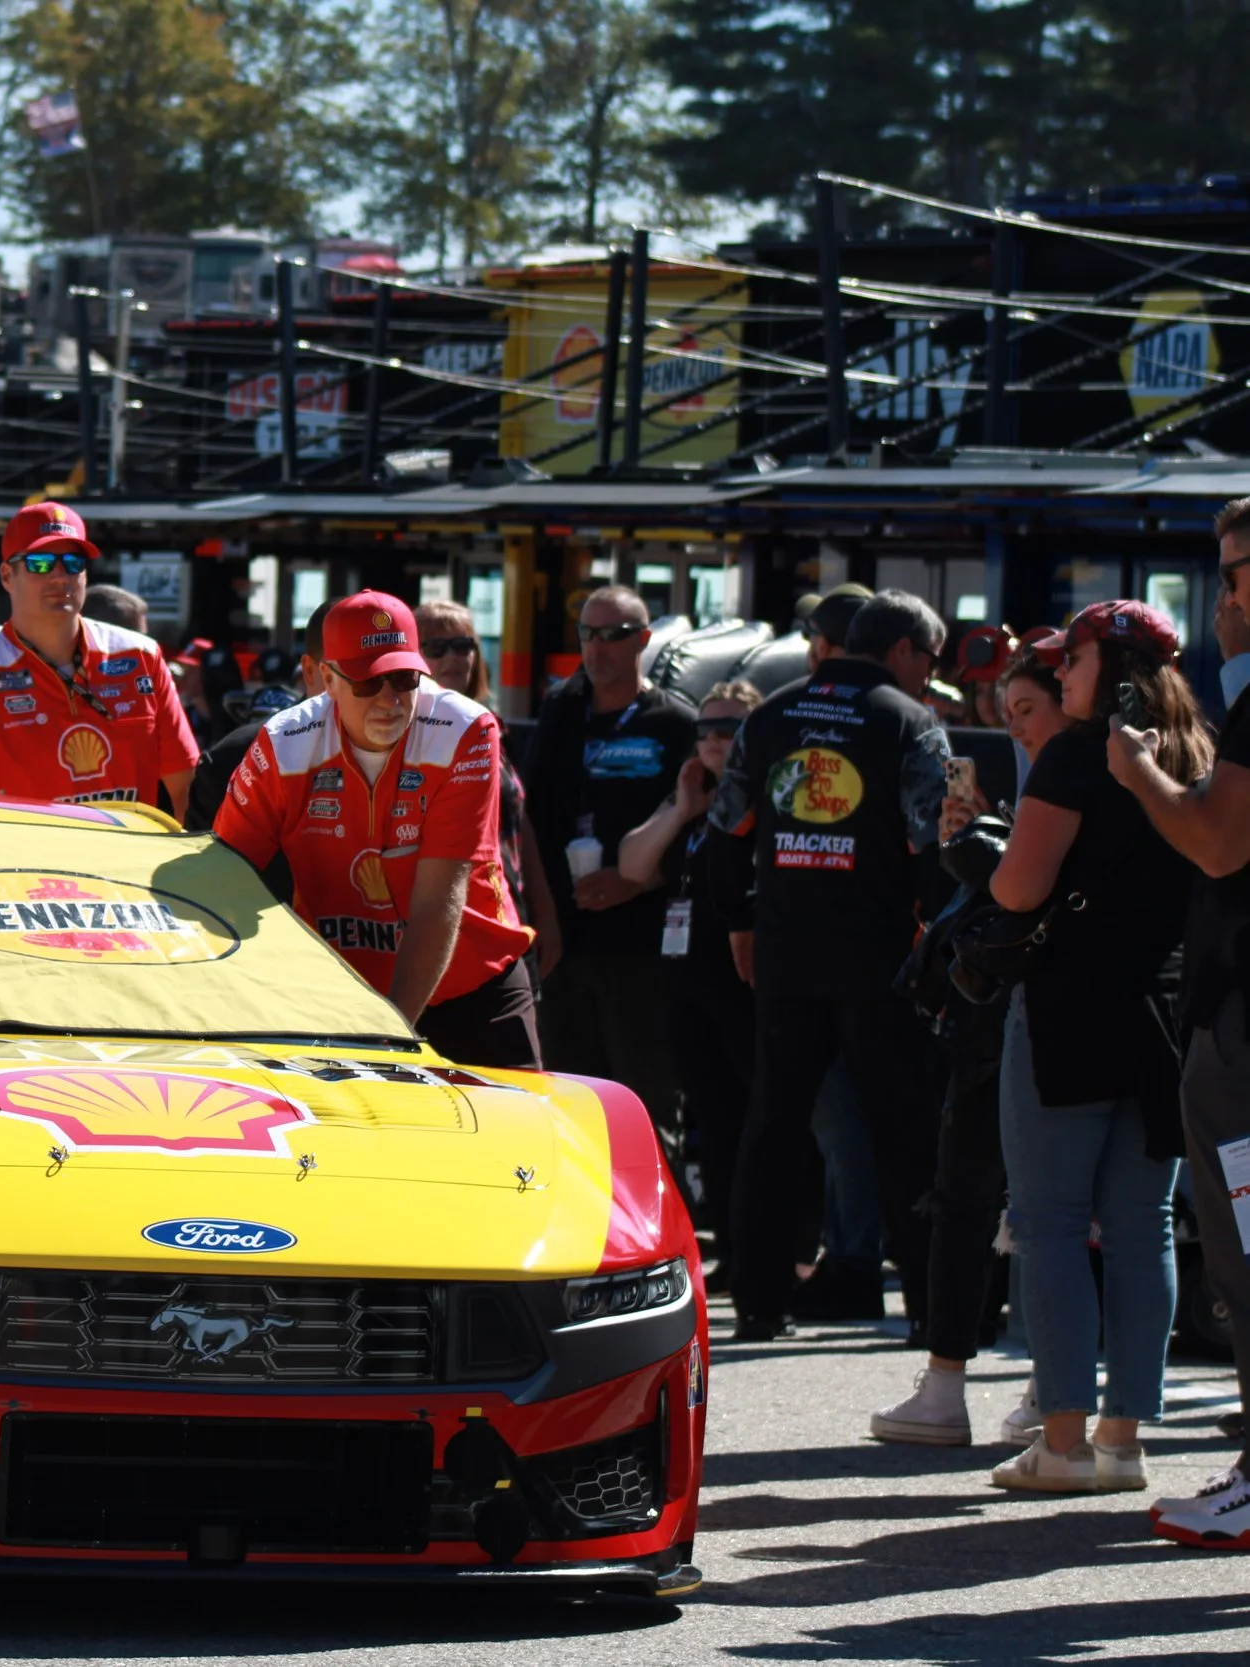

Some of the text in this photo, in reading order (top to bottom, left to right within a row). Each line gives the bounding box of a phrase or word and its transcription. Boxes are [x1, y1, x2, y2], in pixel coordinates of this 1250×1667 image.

[642, 344, 726, 395] ENNZOIL
[1136, 332, 1203, 389] NAPA
[361, 631, 407, 649] PENNZOIL
[797, 701, 854, 714] BASSPRO.COM
[805, 749, 842, 775] Bass
[805, 773, 832, 796] Pro
[774, 832, 855, 855] TRACKER
[777, 853, 811, 864] BOATS
[174, 1221, 267, 1248] Ford
